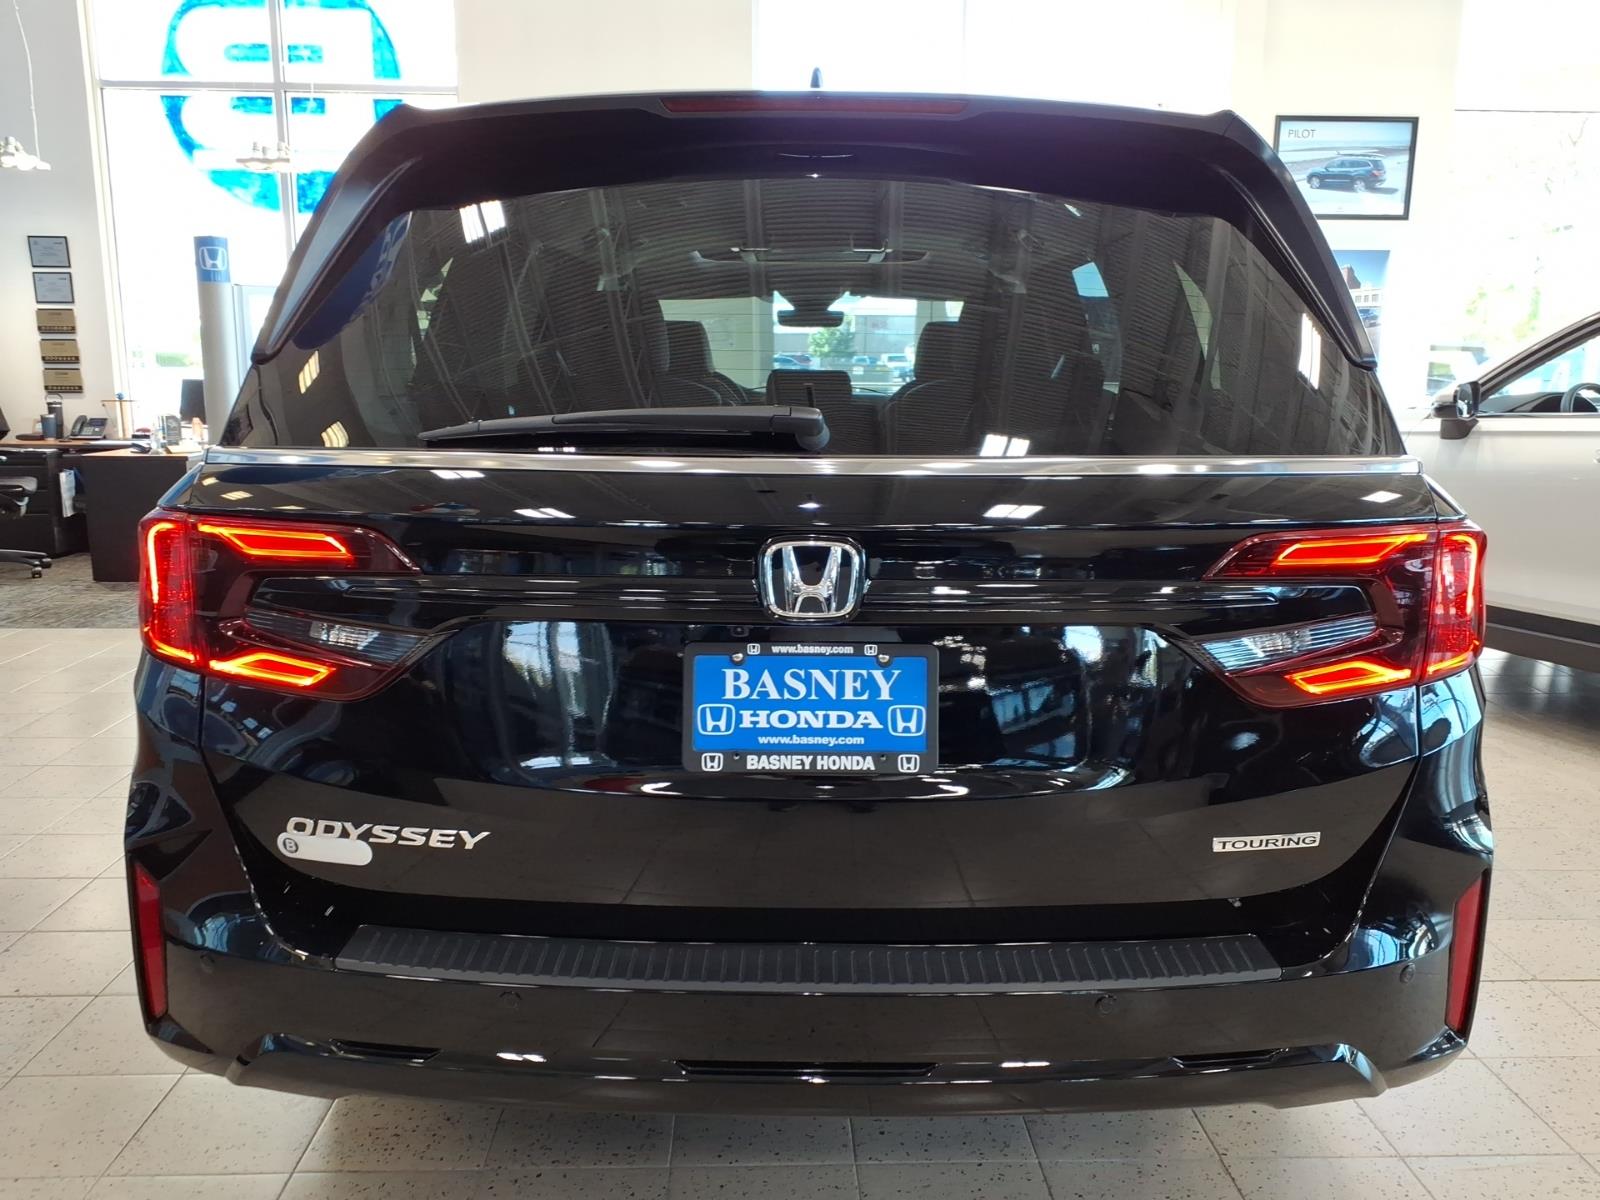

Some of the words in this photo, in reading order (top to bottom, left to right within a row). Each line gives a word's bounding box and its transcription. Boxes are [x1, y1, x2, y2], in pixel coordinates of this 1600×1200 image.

[1287, 129, 1317, 139] PILOT
[771, 643, 854, 655] www.basney.com
[721, 668, 902, 701] BASNEY
[738, 709, 884, 729] HONDA
[757, 735, 865, 746] www.basney.com
[746, 754, 812, 770] BASNEY
[816, 755, 876, 771] HONDA
[286, 816, 492, 850] ODYSSEY
[1217, 836, 1317, 850] TOURING
